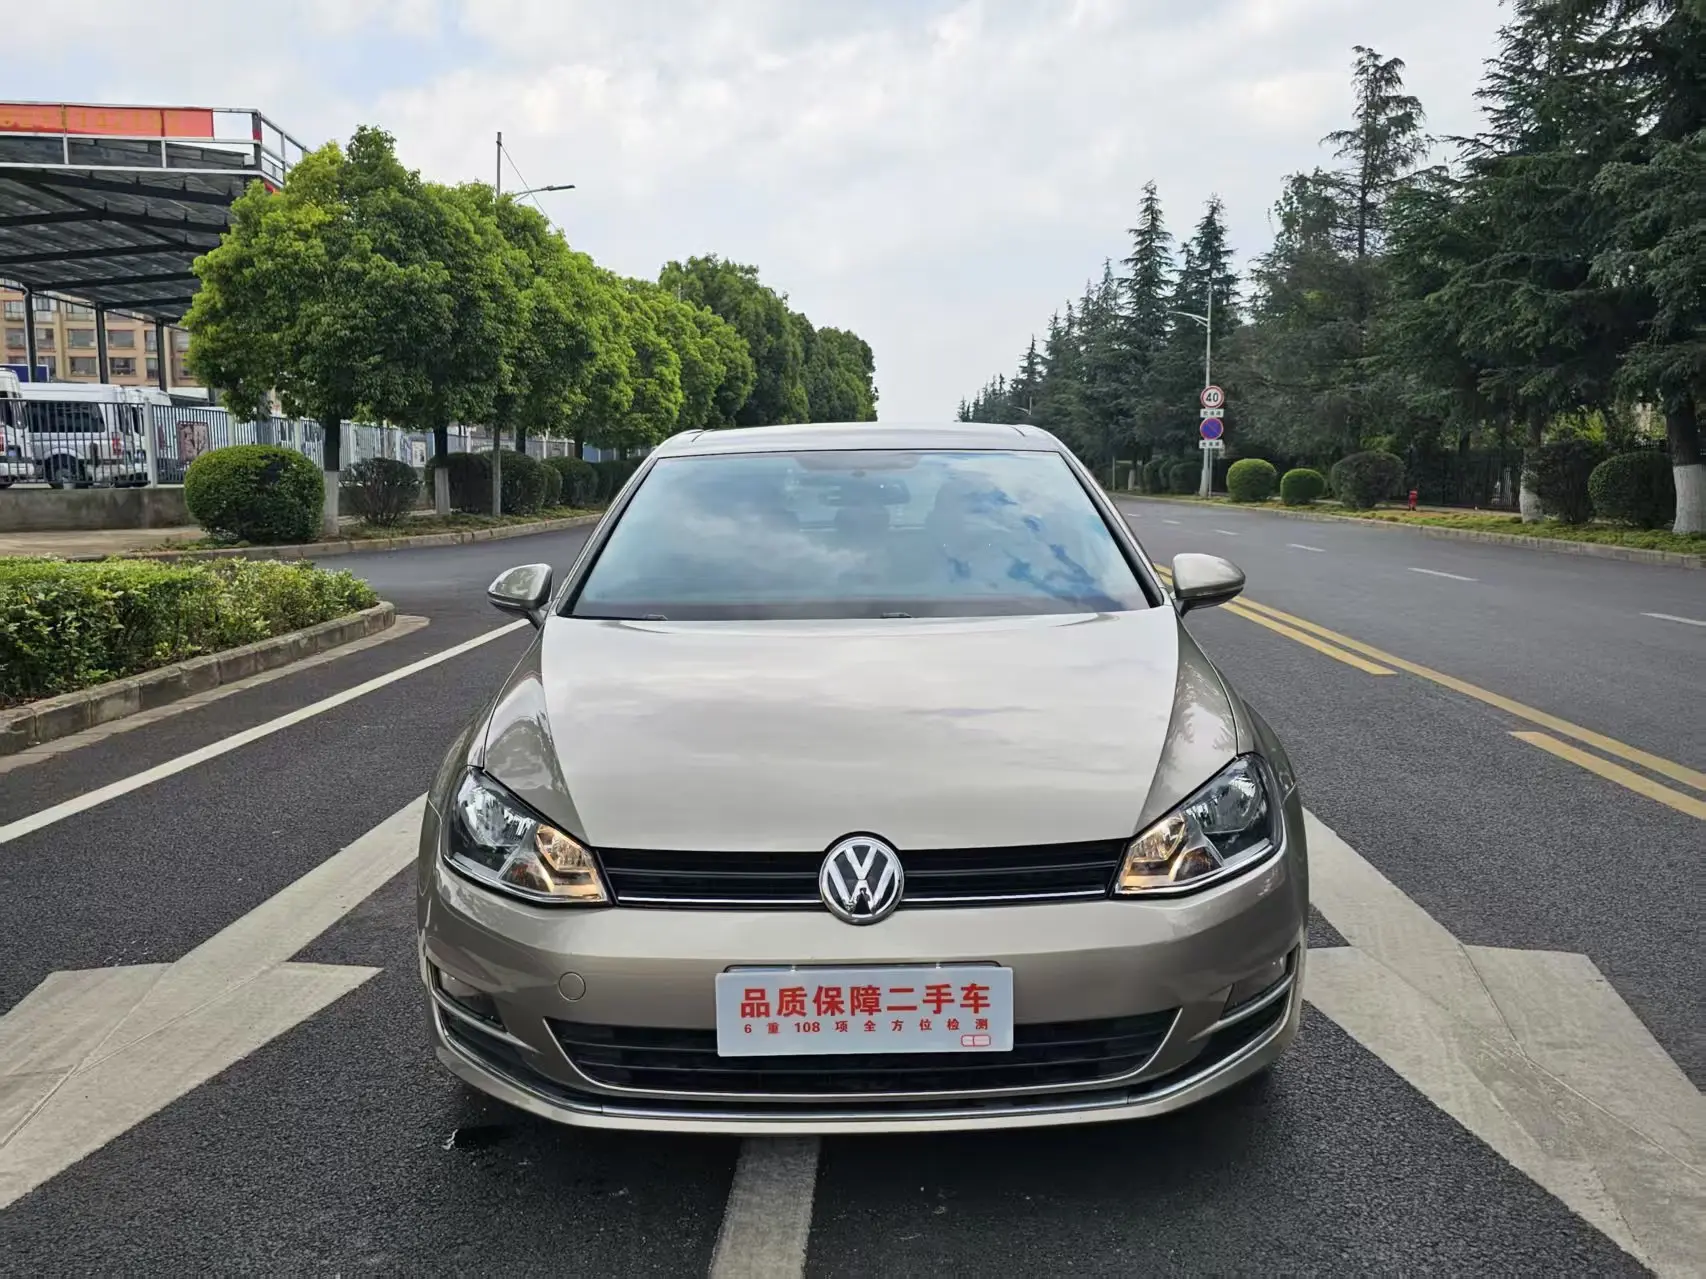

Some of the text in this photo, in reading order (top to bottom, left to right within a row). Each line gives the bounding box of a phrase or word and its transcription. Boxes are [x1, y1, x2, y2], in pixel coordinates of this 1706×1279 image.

[1206, 392, 1219, 402] 40
[740, 983, 991, 1018] 品质保障二手车
